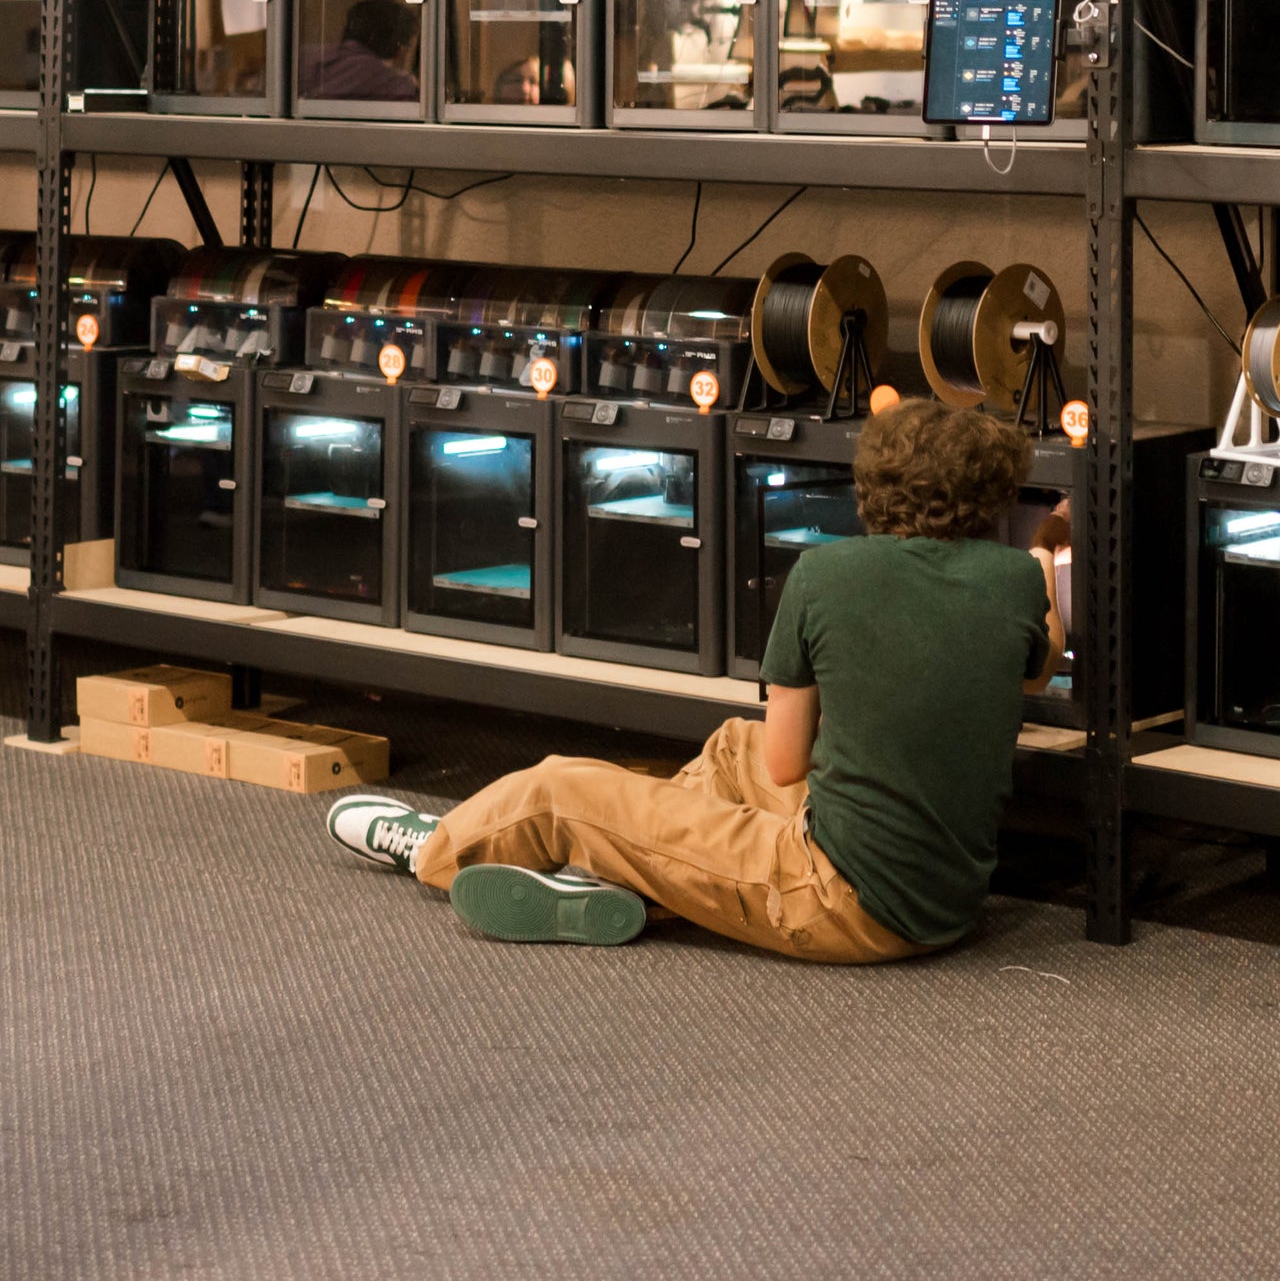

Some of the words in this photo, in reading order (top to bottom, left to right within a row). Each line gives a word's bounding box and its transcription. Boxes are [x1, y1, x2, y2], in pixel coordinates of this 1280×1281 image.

[81, 323, 96, 336] 24
[383, 354, 401, 369] 28
[534, 367, 552, 383] 30
[695, 380, 715, 397] 32
[1066, 410, 1089, 428] 36
